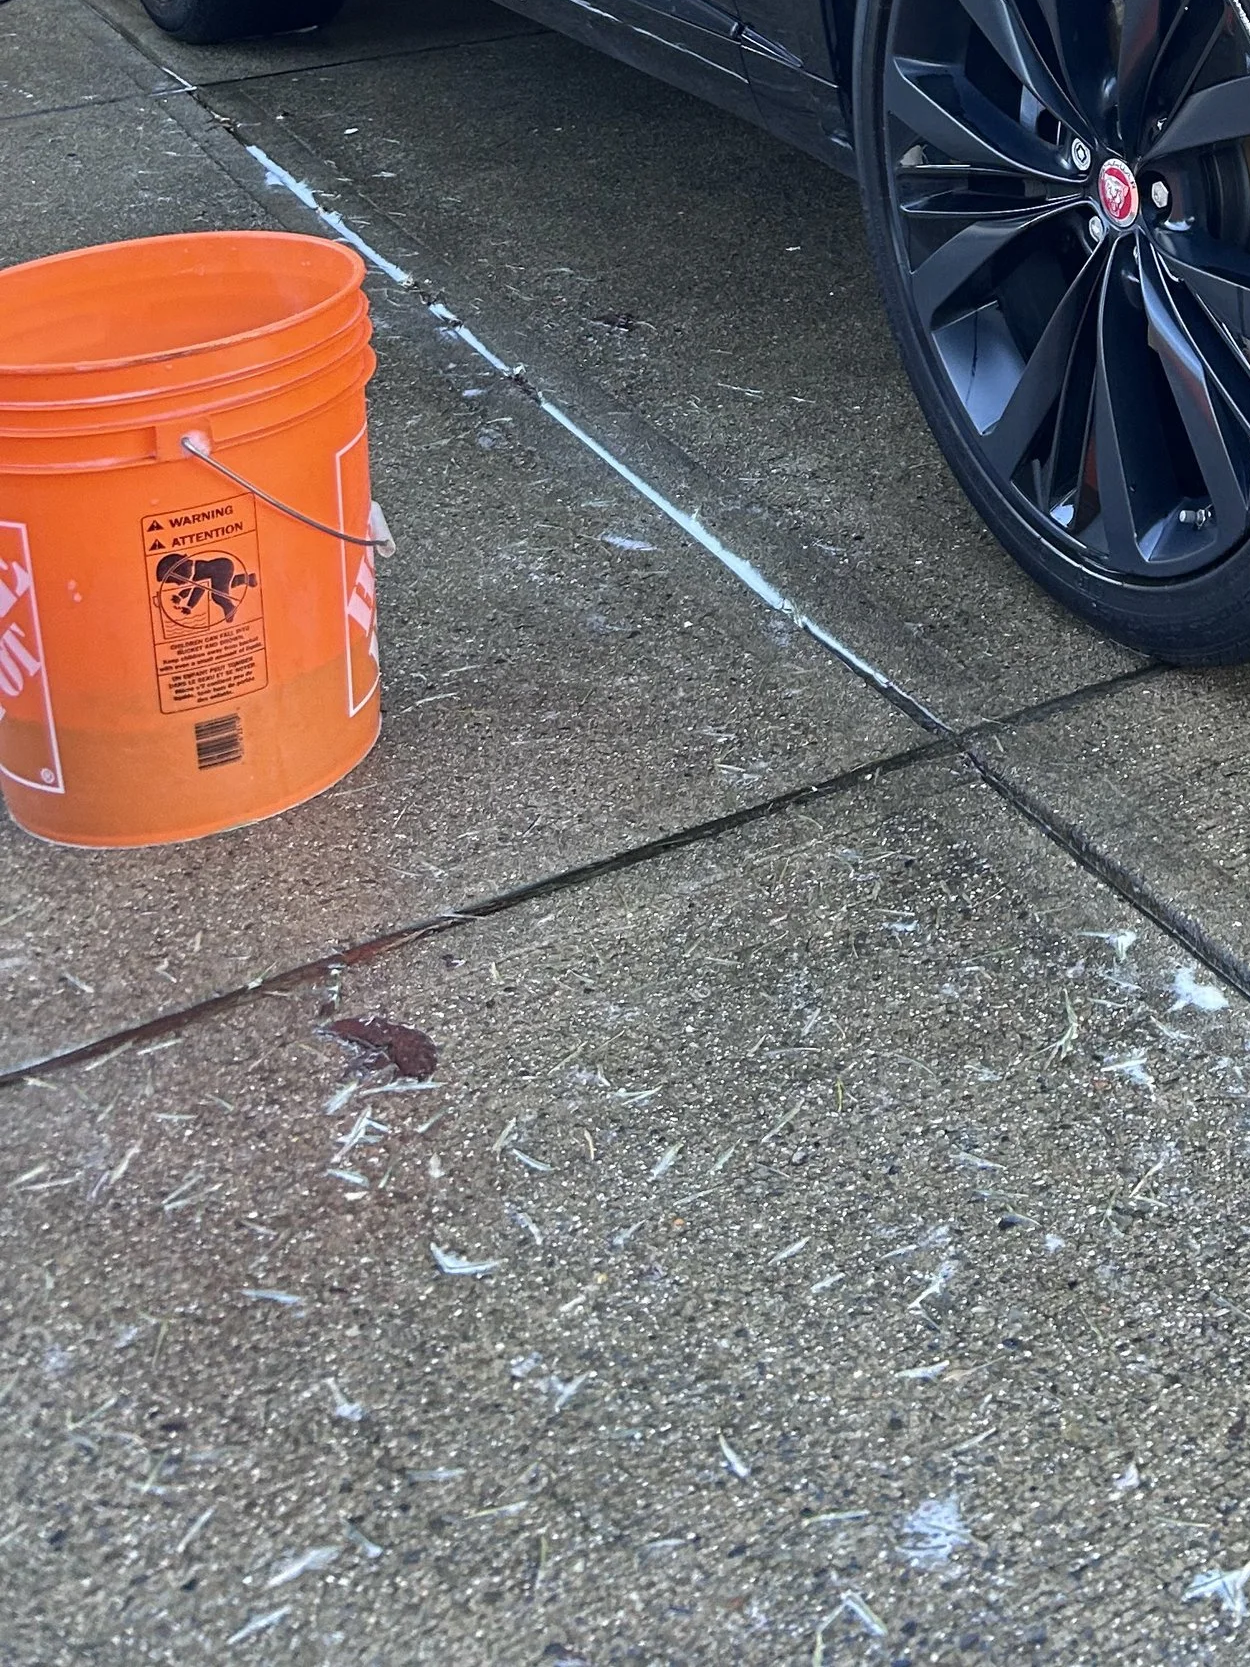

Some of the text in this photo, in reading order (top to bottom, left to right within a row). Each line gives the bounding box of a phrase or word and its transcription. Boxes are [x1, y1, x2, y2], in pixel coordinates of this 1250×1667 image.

[169, 505, 235, 528] WARNING
[171, 521, 244, 549] ATTENTION
[170, 639, 204, 651] CHILDREN
[204, 635, 219, 643] CAN
[219, 630, 234, 639] FALL
[177, 645, 203, 656] BUCKET
[205, 641, 219, 650] AND
